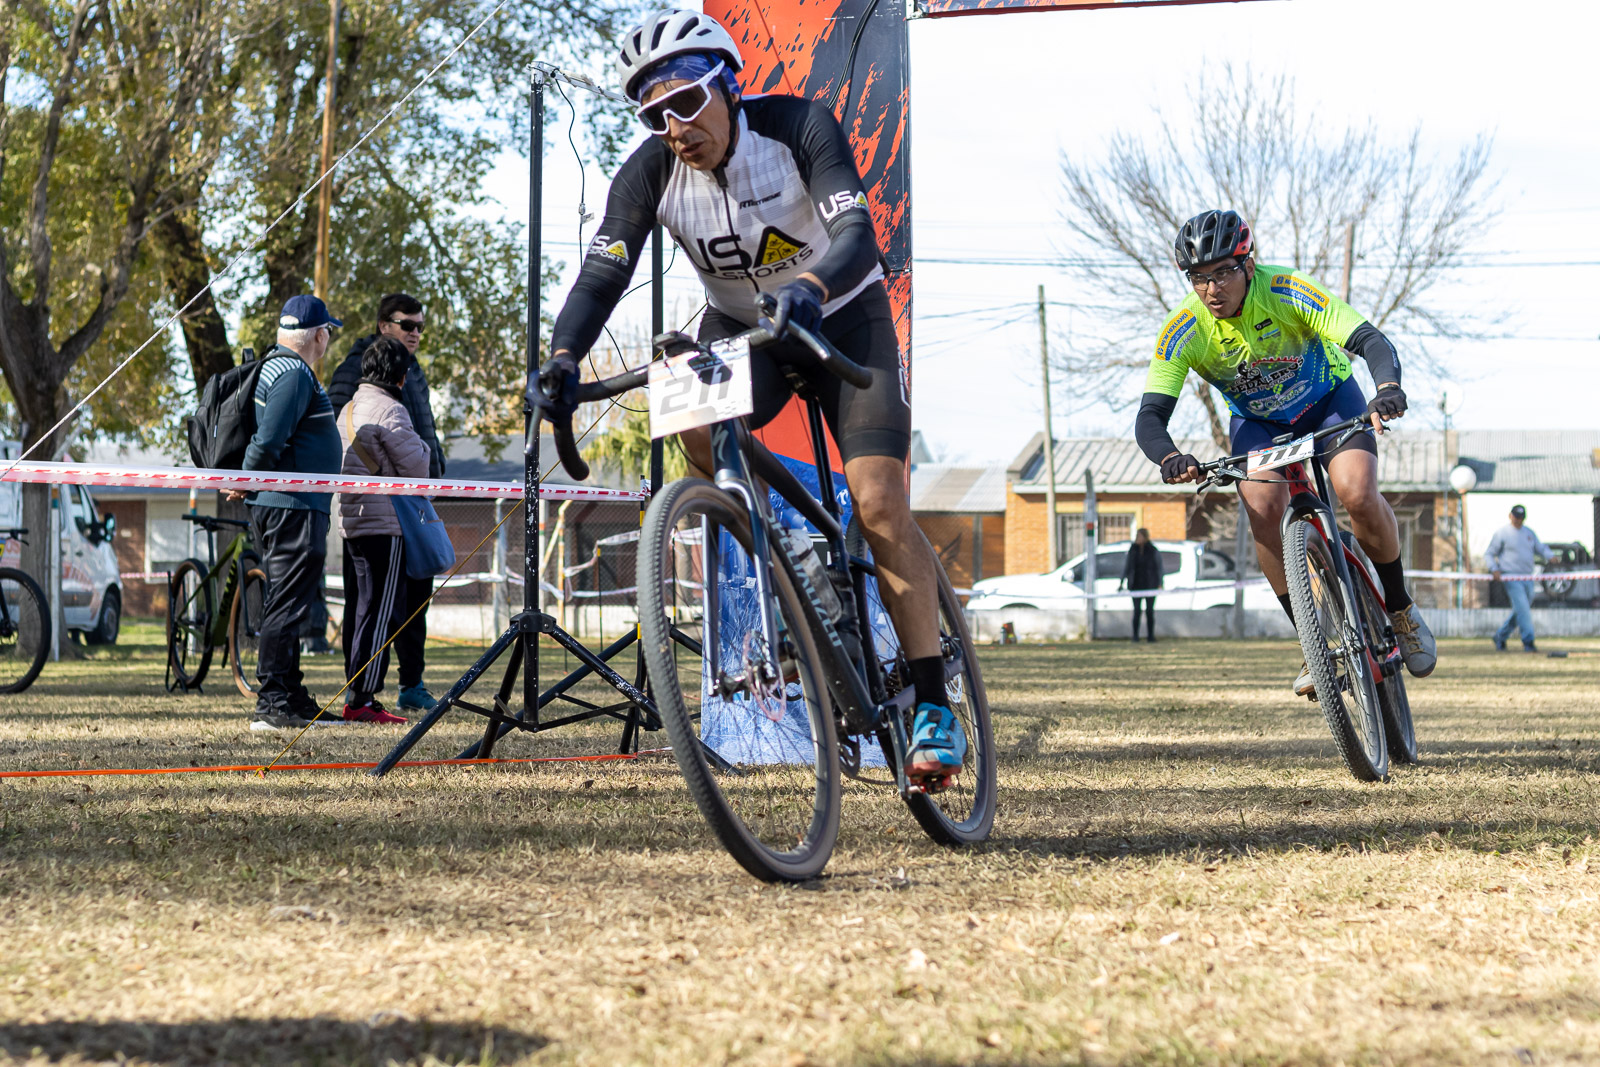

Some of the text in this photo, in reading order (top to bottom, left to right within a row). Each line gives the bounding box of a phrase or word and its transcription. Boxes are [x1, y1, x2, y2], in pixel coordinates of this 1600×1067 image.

[819, 190, 868, 222] USA
[675, 225, 809, 280] USA
[722, 245, 814, 280] SPORTS
[1299, 284, 1325, 303] HOLLAND
[660, 364, 733, 415] 211
[1259, 444, 1302, 466] 111
